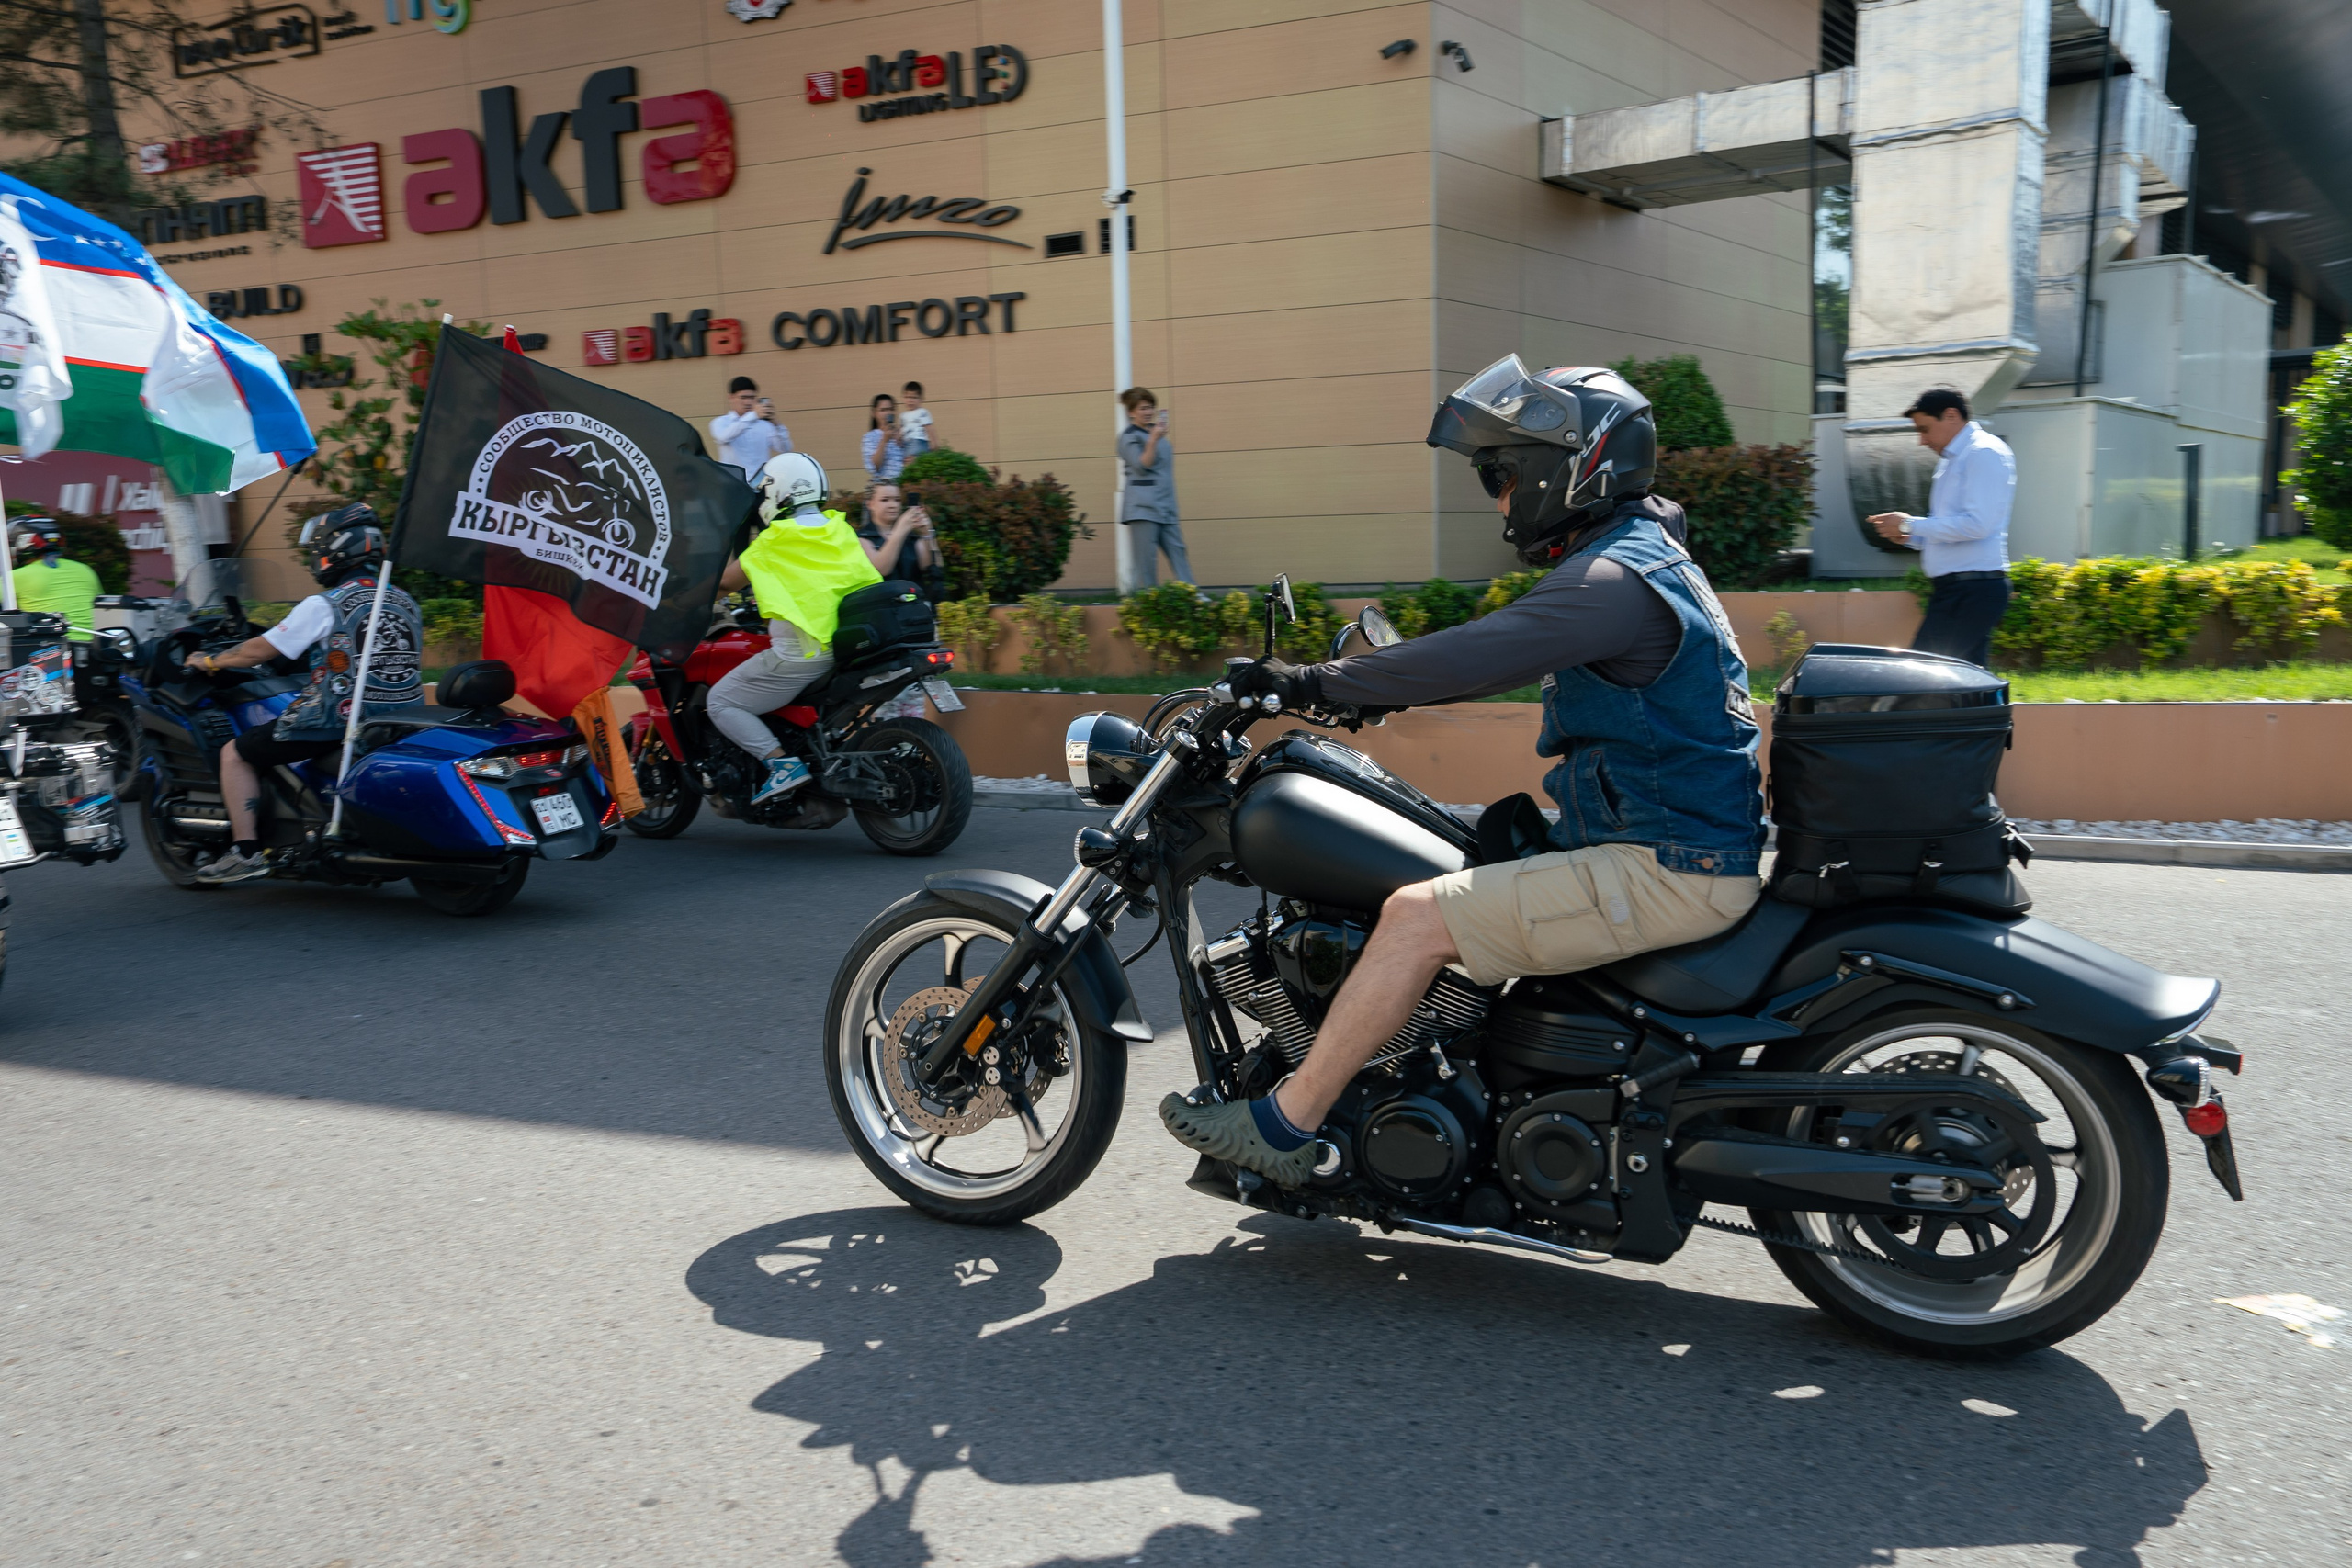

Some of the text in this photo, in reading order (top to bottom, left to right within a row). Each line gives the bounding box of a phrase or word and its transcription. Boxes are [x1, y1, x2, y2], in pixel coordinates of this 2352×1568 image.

[402, 66, 736, 234] akfa
[209, 283, 304, 321] BUILD
[625, 290, 1026, 363] akfa COMFORT
[479, 412, 670, 543] СООБЩЕСТВО МОТОЦИКЛИСТОВ
